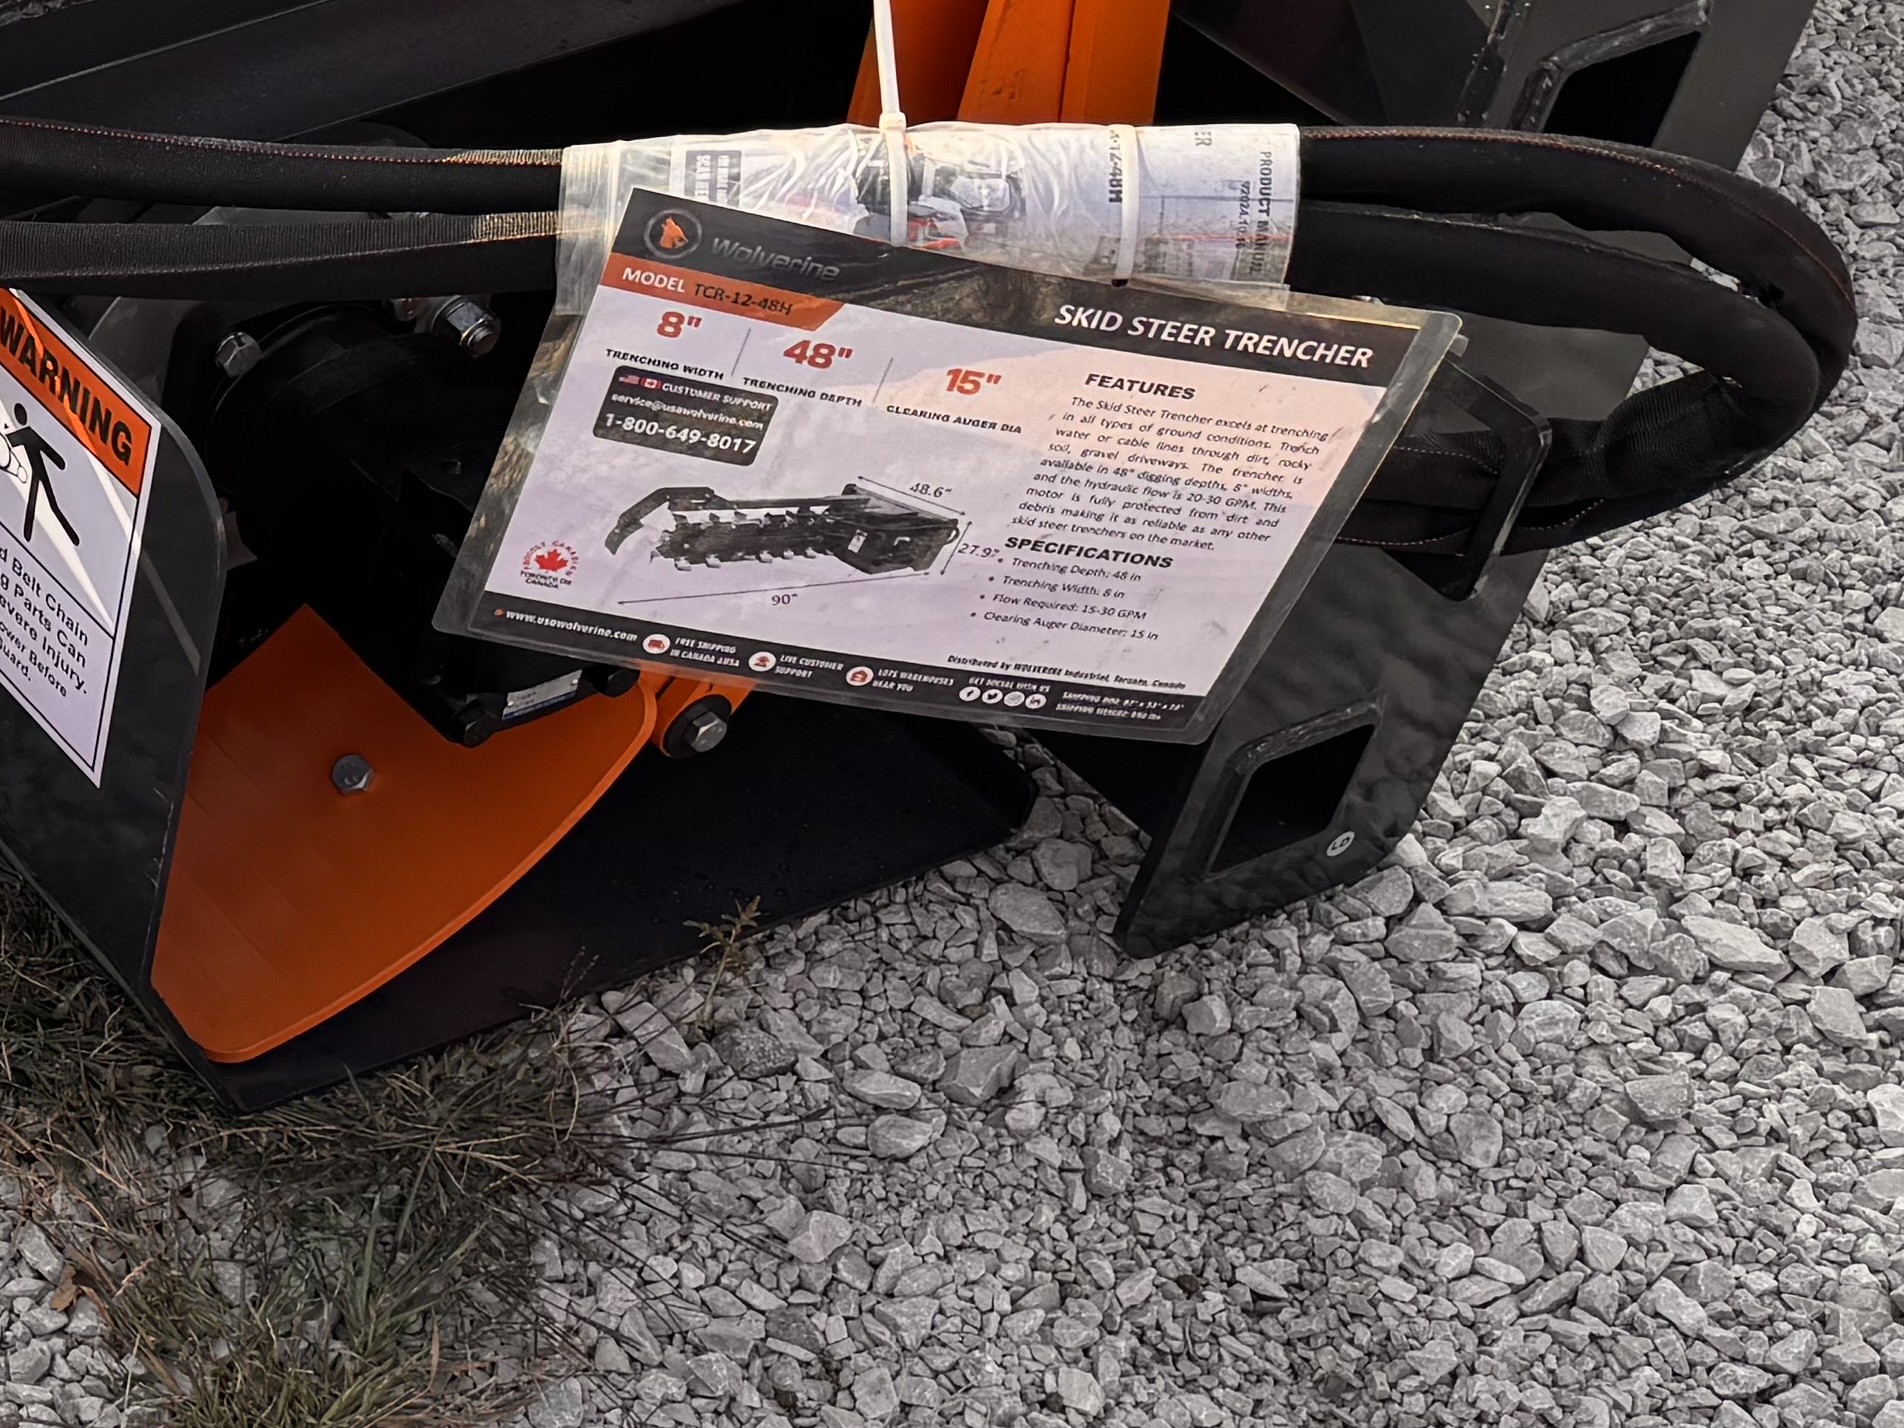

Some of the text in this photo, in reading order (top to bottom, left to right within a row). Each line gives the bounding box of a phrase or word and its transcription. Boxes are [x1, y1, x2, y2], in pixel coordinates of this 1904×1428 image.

[1248, 150, 1274, 275] PRODUCT MANUAL
[712, 236, 841, 283] Wolverine
[621, 267, 795, 316] MODEL TCR-12-48H
[655, 310, 703, 339] 8"
[1053, 303, 1375, 369] SKID STEER TRENCHER
[605, 348, 725, 381] TRENCHING WIDTH
[783, 338, 854, 370] 48"
[0, 305, 133, 467] WARNING
[661, 381, 774, 413] CUSTOMER SUPPORT
[742, 376, 863, 408] TRENCHING DEPTH
[945, 367, 1002, 396] 15"
[1084, 373, 1196, 401] FEATURES
[604, 413, 758, 455] 1-800-649-8017
[885, 403, 1023, 435] CLEARING AUGER DIA
[1062, 412, 1075, 422] in
[1100, 417, 1133, 431] types
[1138, 422, 1154, 434] of
[1156, 426, 1202, 440] ground
[1071, 396, 1094, 409] The
[1096, 399, 1124, 414] Skid
[1124, 403, 1157, 419] Steer
[1159, 409, 1213, 425] Trencher
[1270, 425, 1329, 443] trenching
[1055, 427, 1091, 441] water
[1097, 433, 1113, 443] or
[1116, 435, 1151, 449] cable
[1156, 441, 1185, 454] lines
[1192, 446, 1240, 462] through
[1040, 458, 1094, 473] available
[1096, 464, 1109, 475] in
[1136, 470, 1182, 486] digging
[1080, 448, 1120, 461] gravel
[1201, 462, 1224, 475] The
[1232, 467, 1285, 483] trencher
[1293, 475, 1304, 485] is
[909, 481, 953, 499] 48.6"
[1033, 472, 1057, 484] and
[1060, 475, 1082, 487] the
[1084, 478, 1139, 495] hydraulic
[1142, 486, 1170, 499] flow
[1172, 490, 1183, 501] is
[1186, 492, 1222, 506] 20-30
[1263, 501, 1288, 514] This
[1018, 501, 1056, 515] debris
[1060, 507, 1105, 523] making
[1109, 513, 1120, 523] it
[1123, 516, 1137, 526] as
[1142, 518, 1188, 532] reliable
[1191, 524, 1206, 534] as
[1237, 530, 1272, 543] other
[1025, 486, 1281, 528] motor is fully protected from dirt and
[1011, 514, 1037, 527] skid
[1037, 519, 1069, 532] steer
[1070, 523, 1128, 539] trenchers
[1128, 530, 1145, 541] on
[1147, 533, 1169, 545] the
[1003, 536, 1175, 569] SPECIFICATIONS
[1002, 574, 1060, 592] Trenching
[1061, 582, 1101, 597] Width:
[1113, 589, 1126, 599] in
[1011, 557, 1142, 583] Trenching Depth: 48 in
[11, 557, 42, 599] Belt
[45, 593, 89, 647] Chain
[771, 592, 799, 606] 90"
[992, 593, 1021, 606] Flow
[1117, 609, 1149, 621] GPM
[14, 582, 52, 633] Parts
[56, 629, 87, 669] Can
[983, 610, 1032, 627] Clearing
[1032, 616, 1069, 630] Auger
[1129, 628, 1145, 640] 15
[1145, 630, 1160, 641] in
[29, 649, 68, 698] Before
[42, 636, 88, 696] Injury.
[780, 654, 797, 664] LIVE
